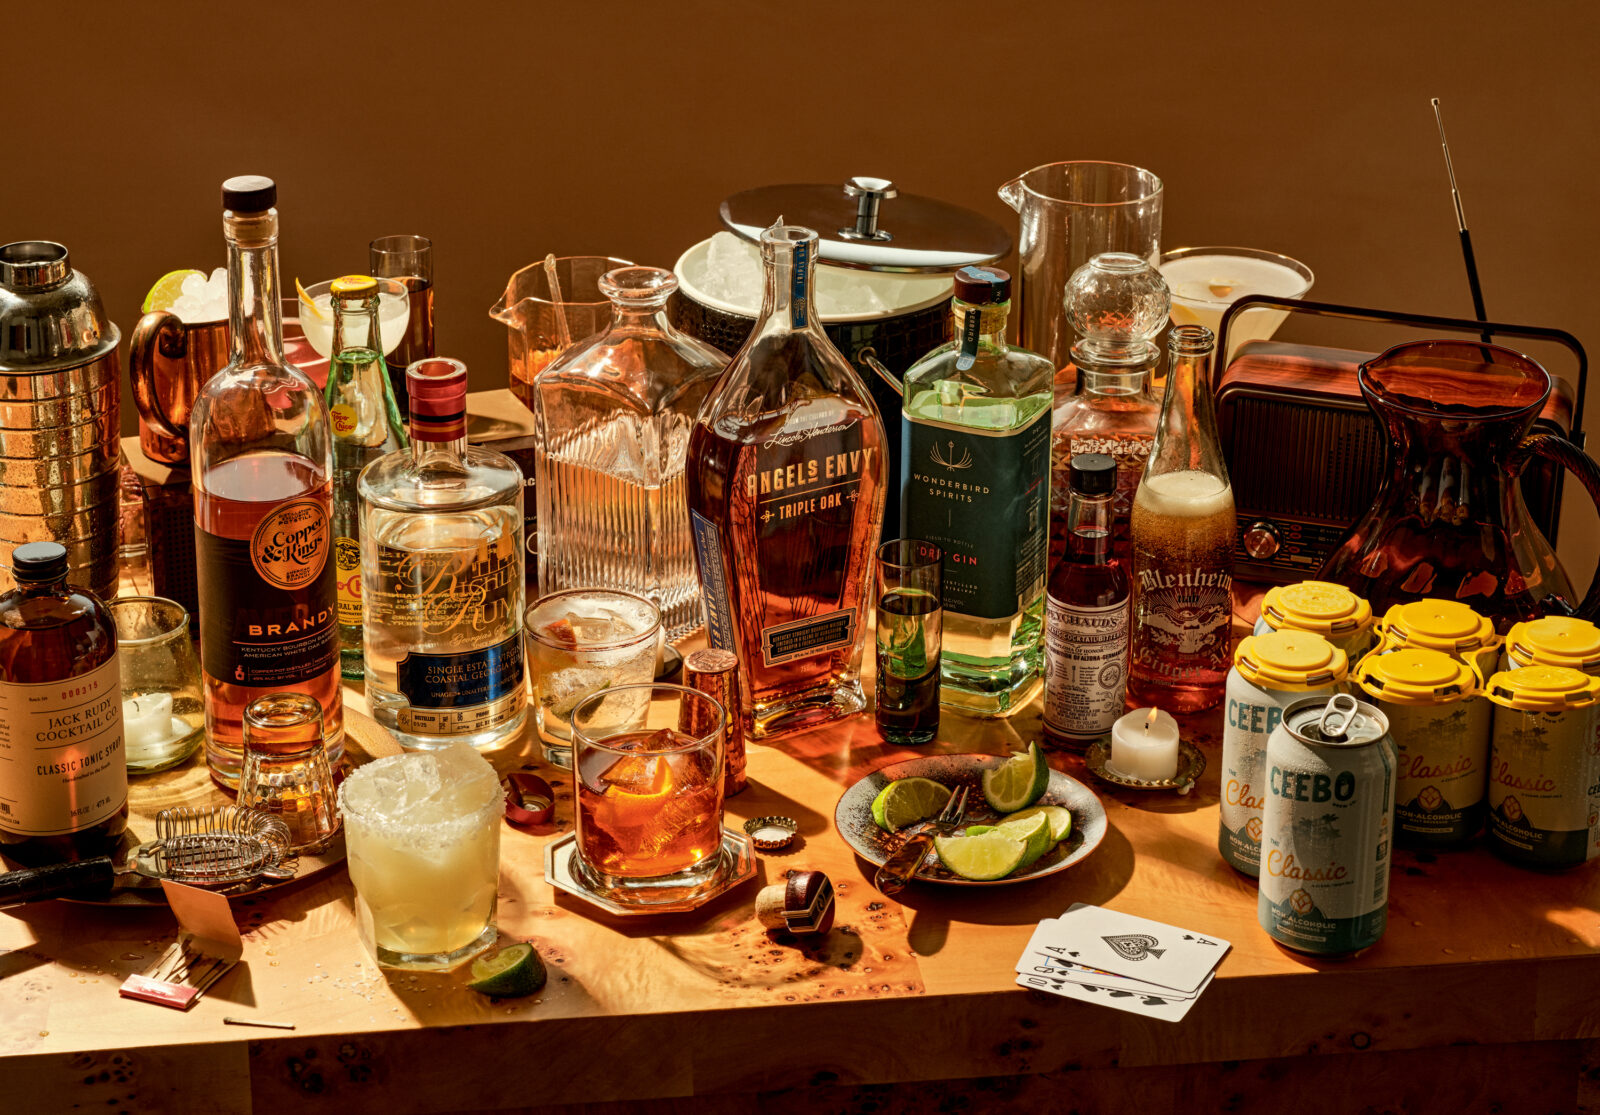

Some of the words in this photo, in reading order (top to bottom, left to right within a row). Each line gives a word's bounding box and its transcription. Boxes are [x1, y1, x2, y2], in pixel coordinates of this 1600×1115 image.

[331, 410, 349, 421] Topo
[335, 420, 355, 431] Chico
[826, 449, 873, 478] ENVY
[914, 473, 990, 494] WONDERBIRD
[779, 499, 815, 520] TRIPLE
[820, 493, 842, 509] OAK
[929, 488, 973, 503] SPIRITS
[272, 516, 323, 547] Copper
[953, 553, 977, 567] GIN
[1138, 567, 1233, 592] Blenheim
[248, 602, 335, 636] BRANDY
[284, 648, 307, 656] WHITE
[424, 674, 470, 685] COASTAL
[471, 663, 509, 680] GEORGIA
[427, 664, 464, 675] SINGLE
[466, 657, 496, 671] ESTATE
[61, 681, 99, 700] 000315
[36, 718, 104, 742] COCKTAIL
[105, 705, 118, 722] CO.
[48, 712, 82, 730] JACK
[85, 697, 113, 720] RUDY
[1228, 699, 1283, 735] CEEB
[37, 761, 77, 776] CLASSIC
[79, 752, 104, 770] TONIC
[105, 736, 122, 758] SYRUP
[1271, 766, 1356, 803] CEEBO
[1490, 756, 1557, 792] Classic
[1267, 849, 1348, 881] Classic
[1271, 906, 1337, 929] NON-ALCOHOLIC
[1045, 945, 1067, 955] A
[1196, 937, 1219, 947] A
[1033, 965, 1055, 974] Q
[1027, 977, 1048, 987] 10
